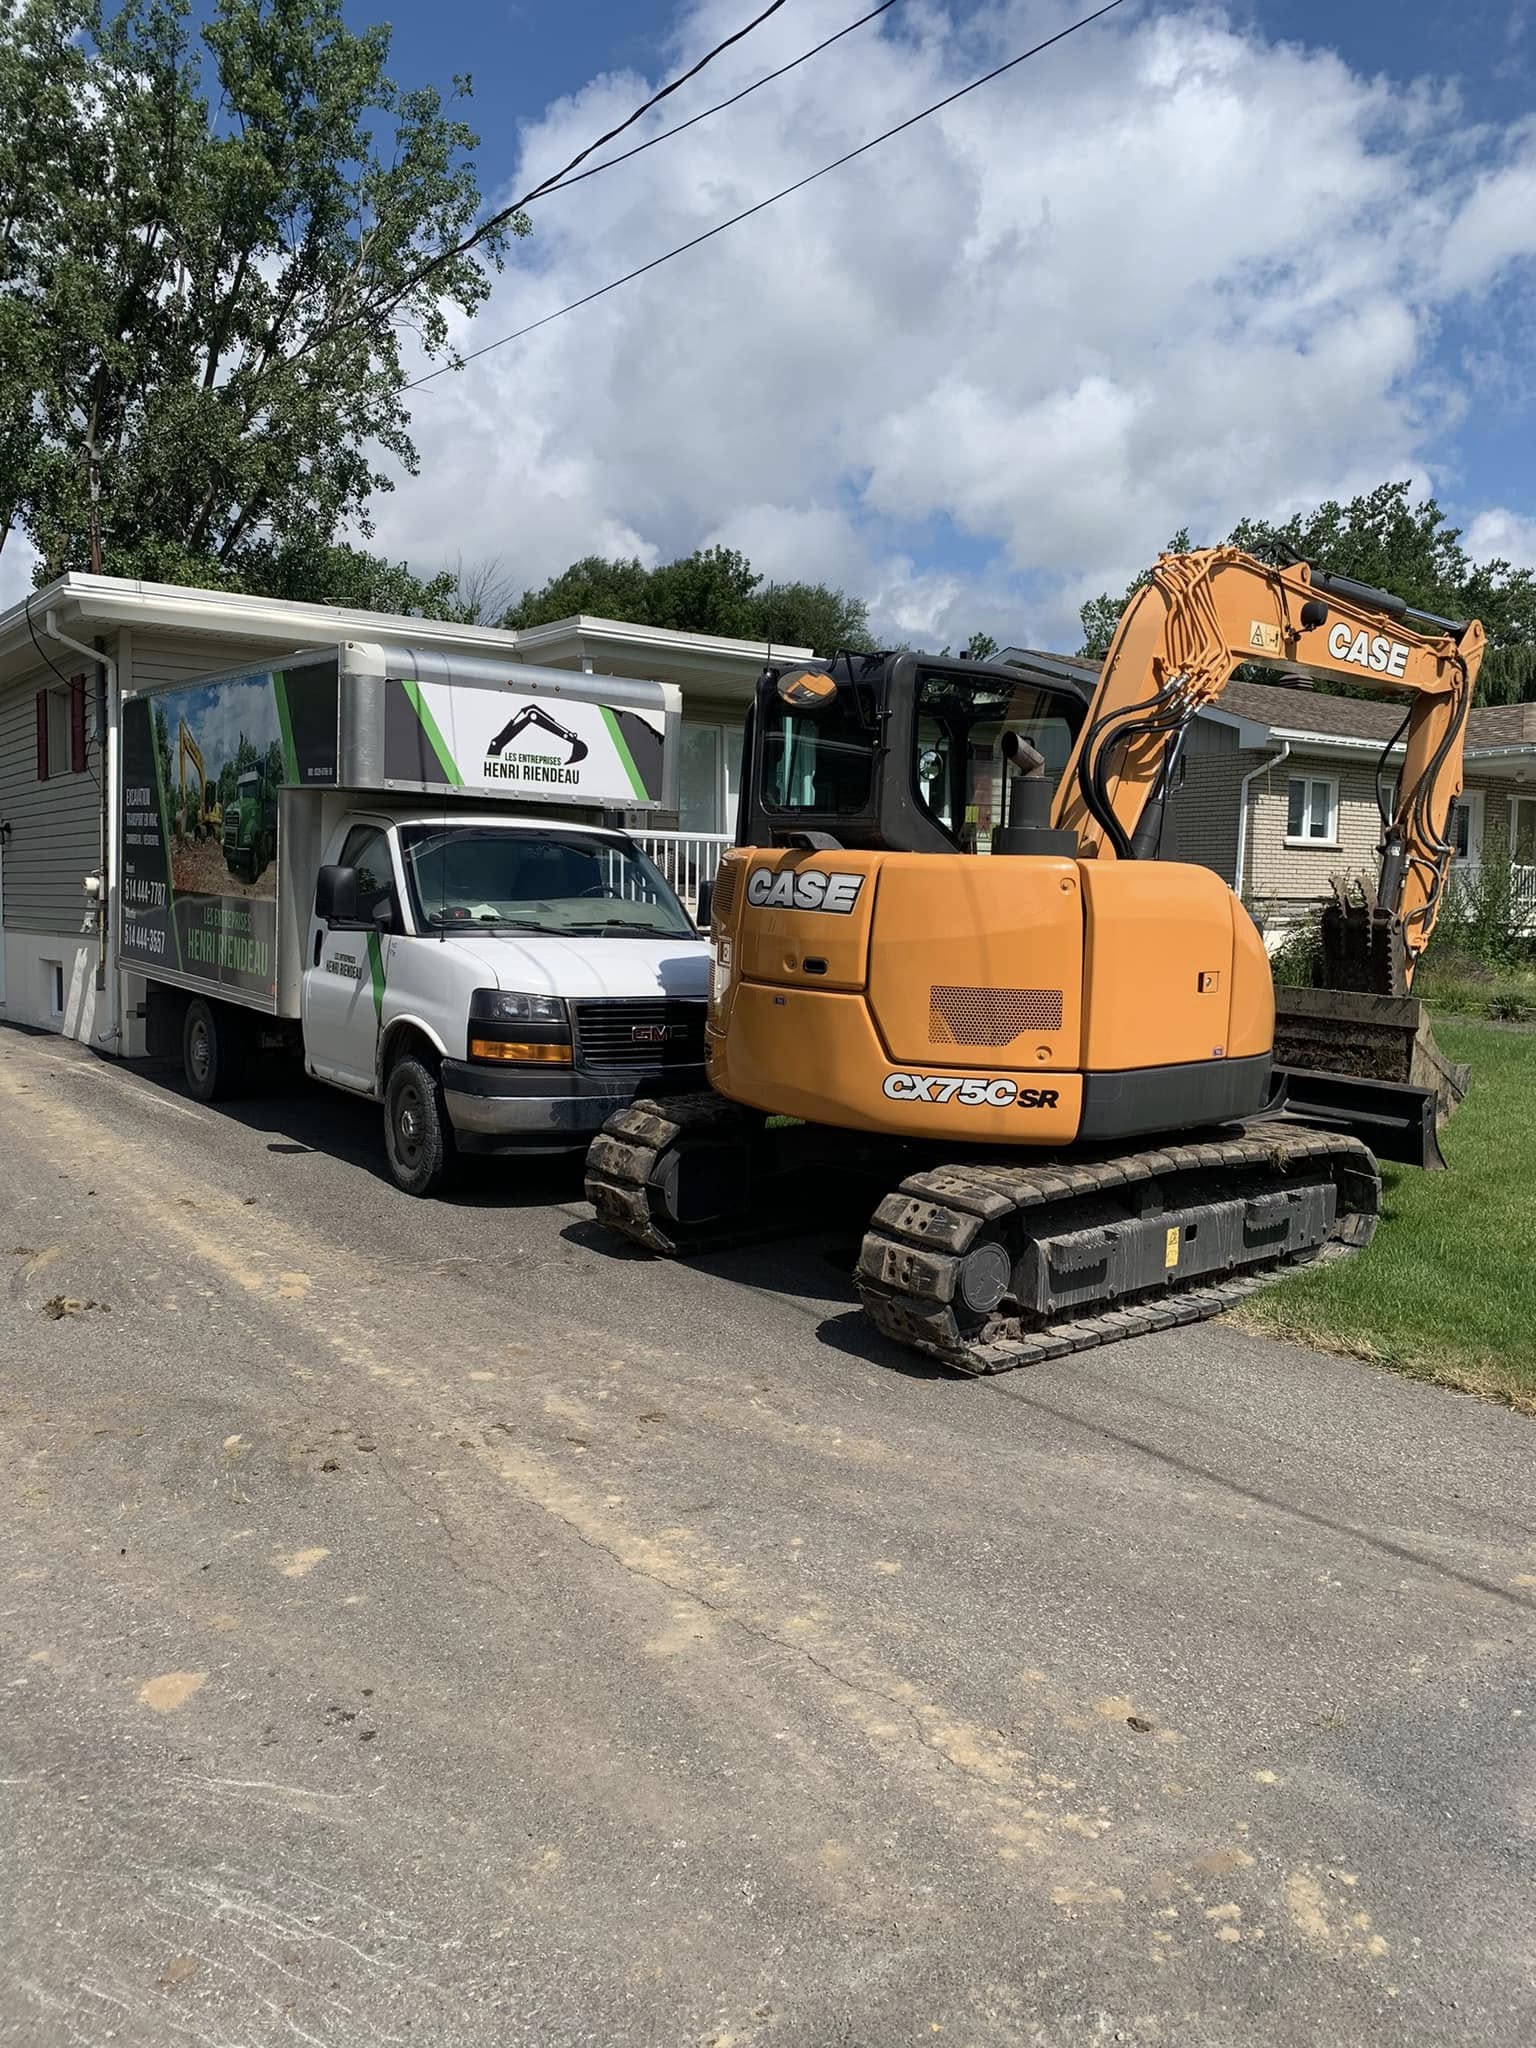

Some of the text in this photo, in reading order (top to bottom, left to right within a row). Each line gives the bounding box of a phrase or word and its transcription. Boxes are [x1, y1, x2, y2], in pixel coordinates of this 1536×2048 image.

[1328, 622, 1410, 678] CASE
[505, 752, 562, 766] LES ENTREPRISES
[484, 761, 580, 785] HENRI RIENDEAU
[125, 878, 137, 901] 514
[749, 868, 864, 914] CASE
[203, 905, 213, 927] LES
[124, 924, 136, 947] 514
[188, 927, 269, 977] HENRI RIENDEAU
[1017, 1089, 1059, 1108] SR
